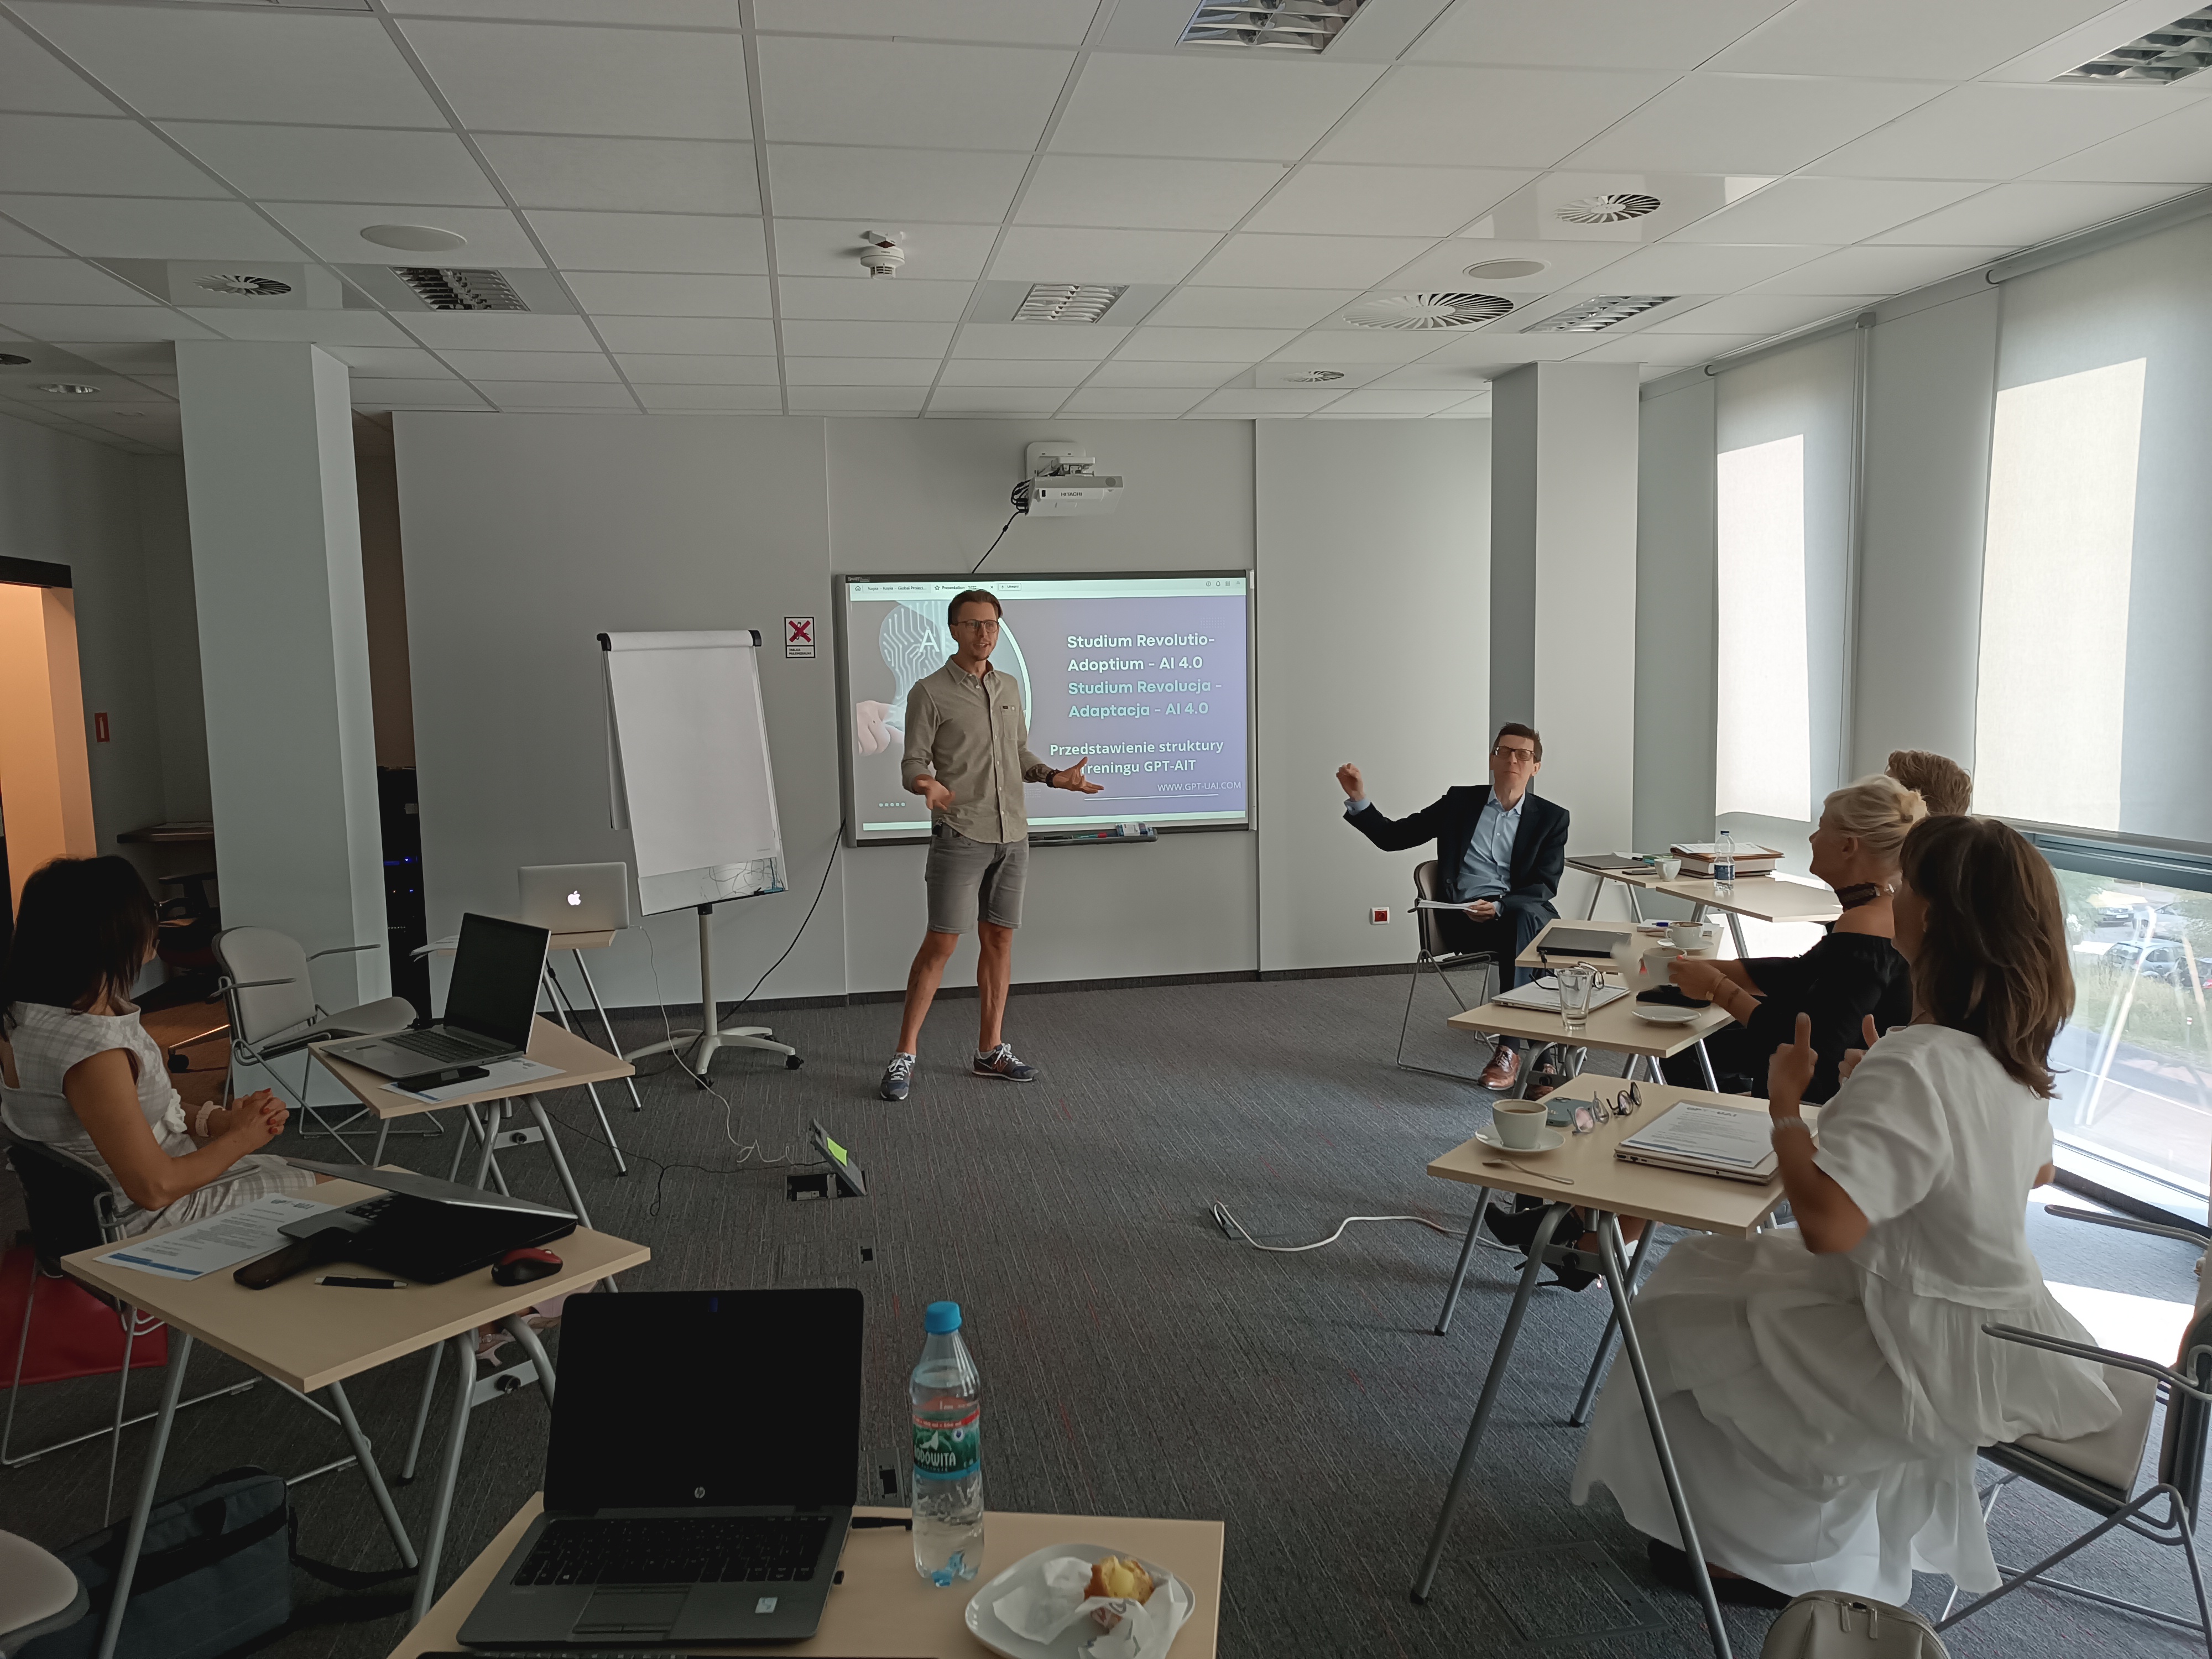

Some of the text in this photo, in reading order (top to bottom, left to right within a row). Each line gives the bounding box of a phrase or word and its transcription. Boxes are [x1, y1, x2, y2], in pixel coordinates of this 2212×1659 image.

[1067, 633, 1215, 648] Studium Revolutio-
[1068, 658, 1144, 673] Adoptium
[1159, 657, 1174, 669] AI
[1178, 656, 1203, 669] 4.0
[1068, 681, 1133, 695] Studium
[1138, 679, 1211, 694] Revolucja
[1068, 703, 1150, 719] Adaptacja
[1165, 703, 1180, 715] AI
[1185, 702, 1208, 714] 4.0
[1051, 740, 1224, 755] Przedstawienie struktury
[1144, 759, 1196, 773] GPT-AIT
[1157, 781, 1241, 791] WWW.GPT-UAI.COM
